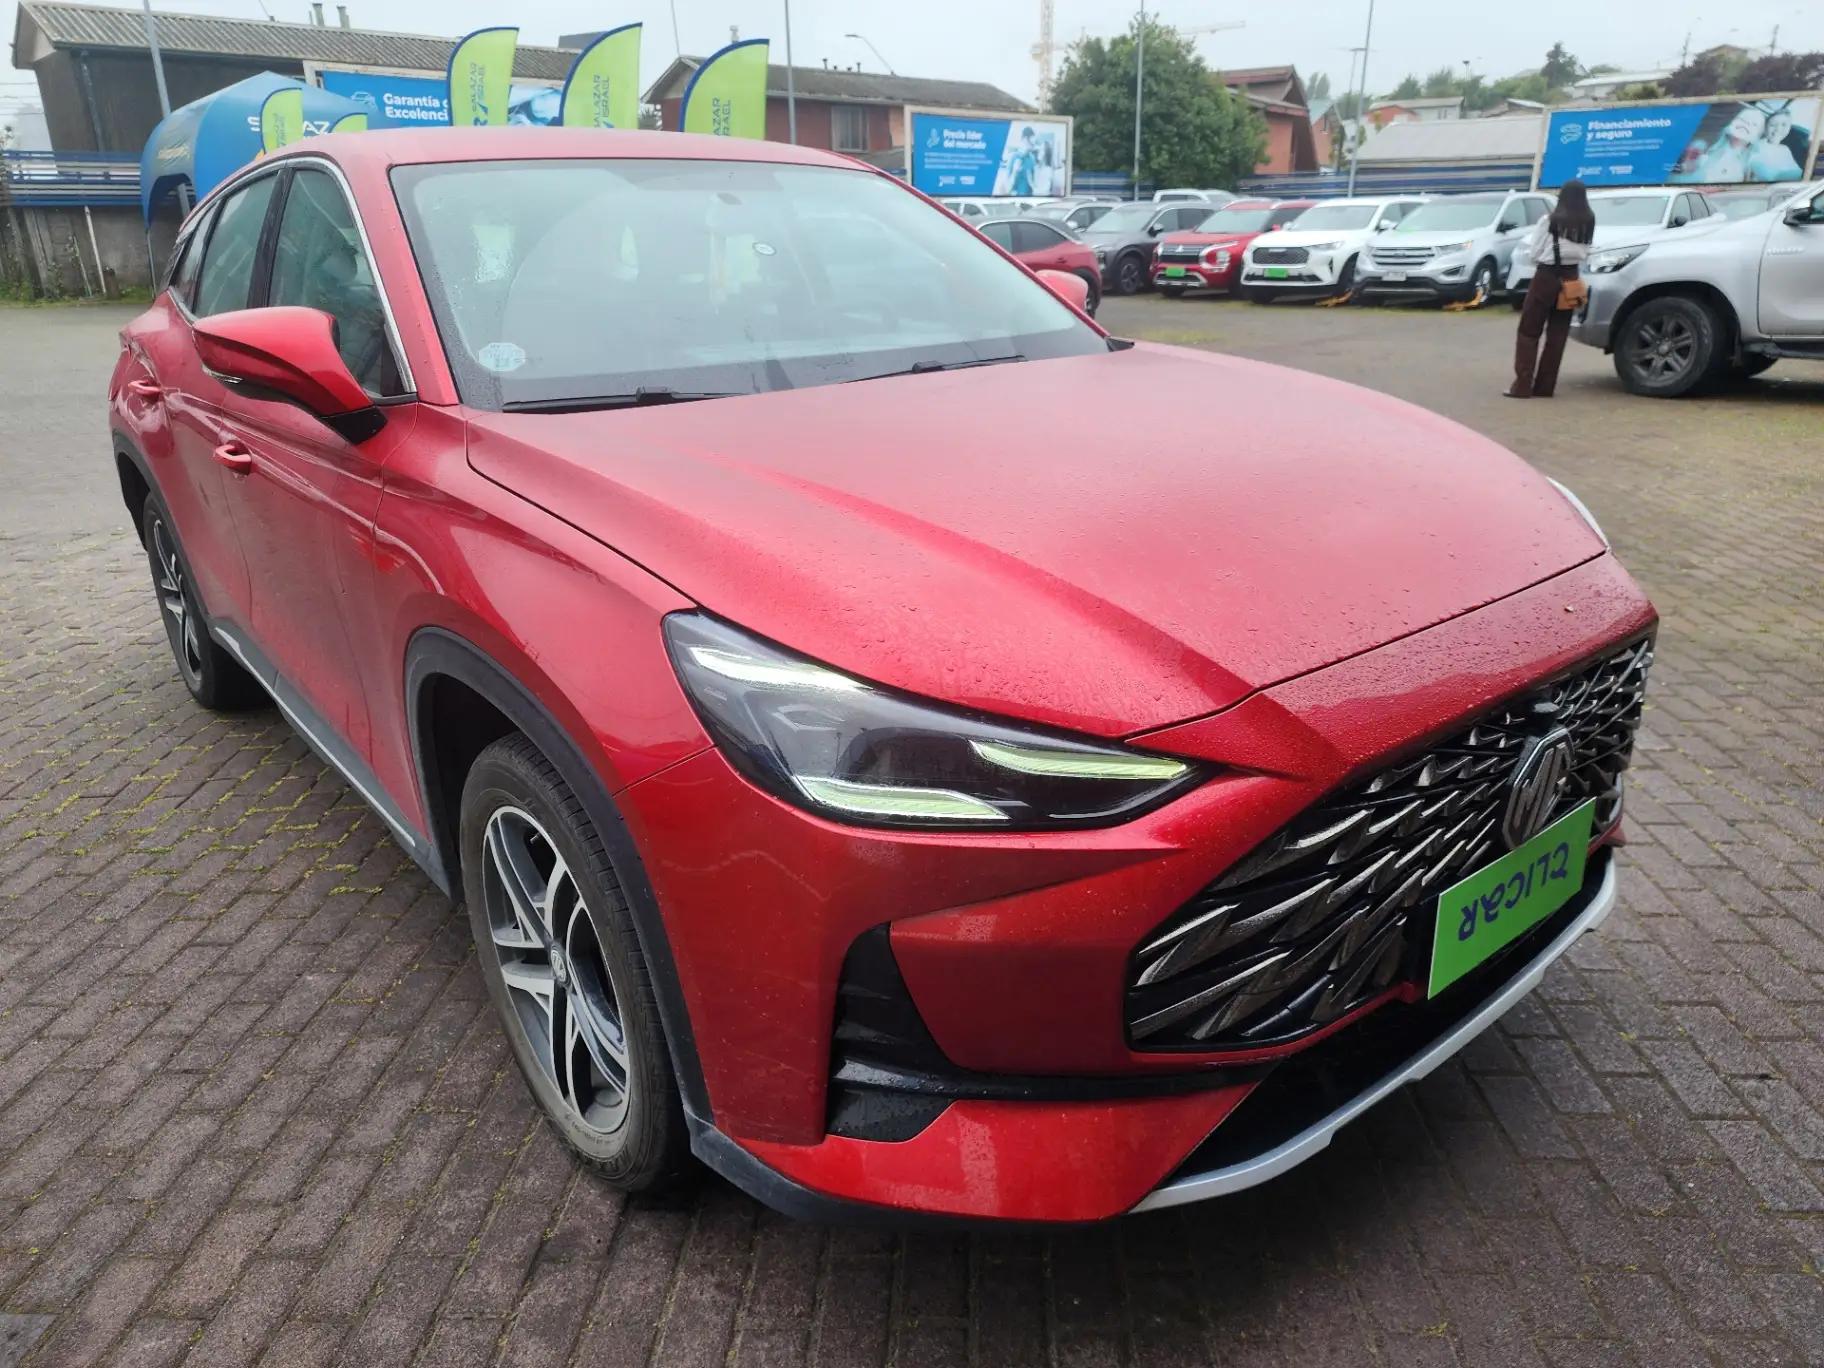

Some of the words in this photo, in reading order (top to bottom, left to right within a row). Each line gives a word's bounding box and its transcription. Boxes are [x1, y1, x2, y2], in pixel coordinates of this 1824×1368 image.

[385, 106, 449, 121] Excelenci
[1588, 118, 1671, 131] Financiamiento
[1595, 130, 1633, 141] seguro
